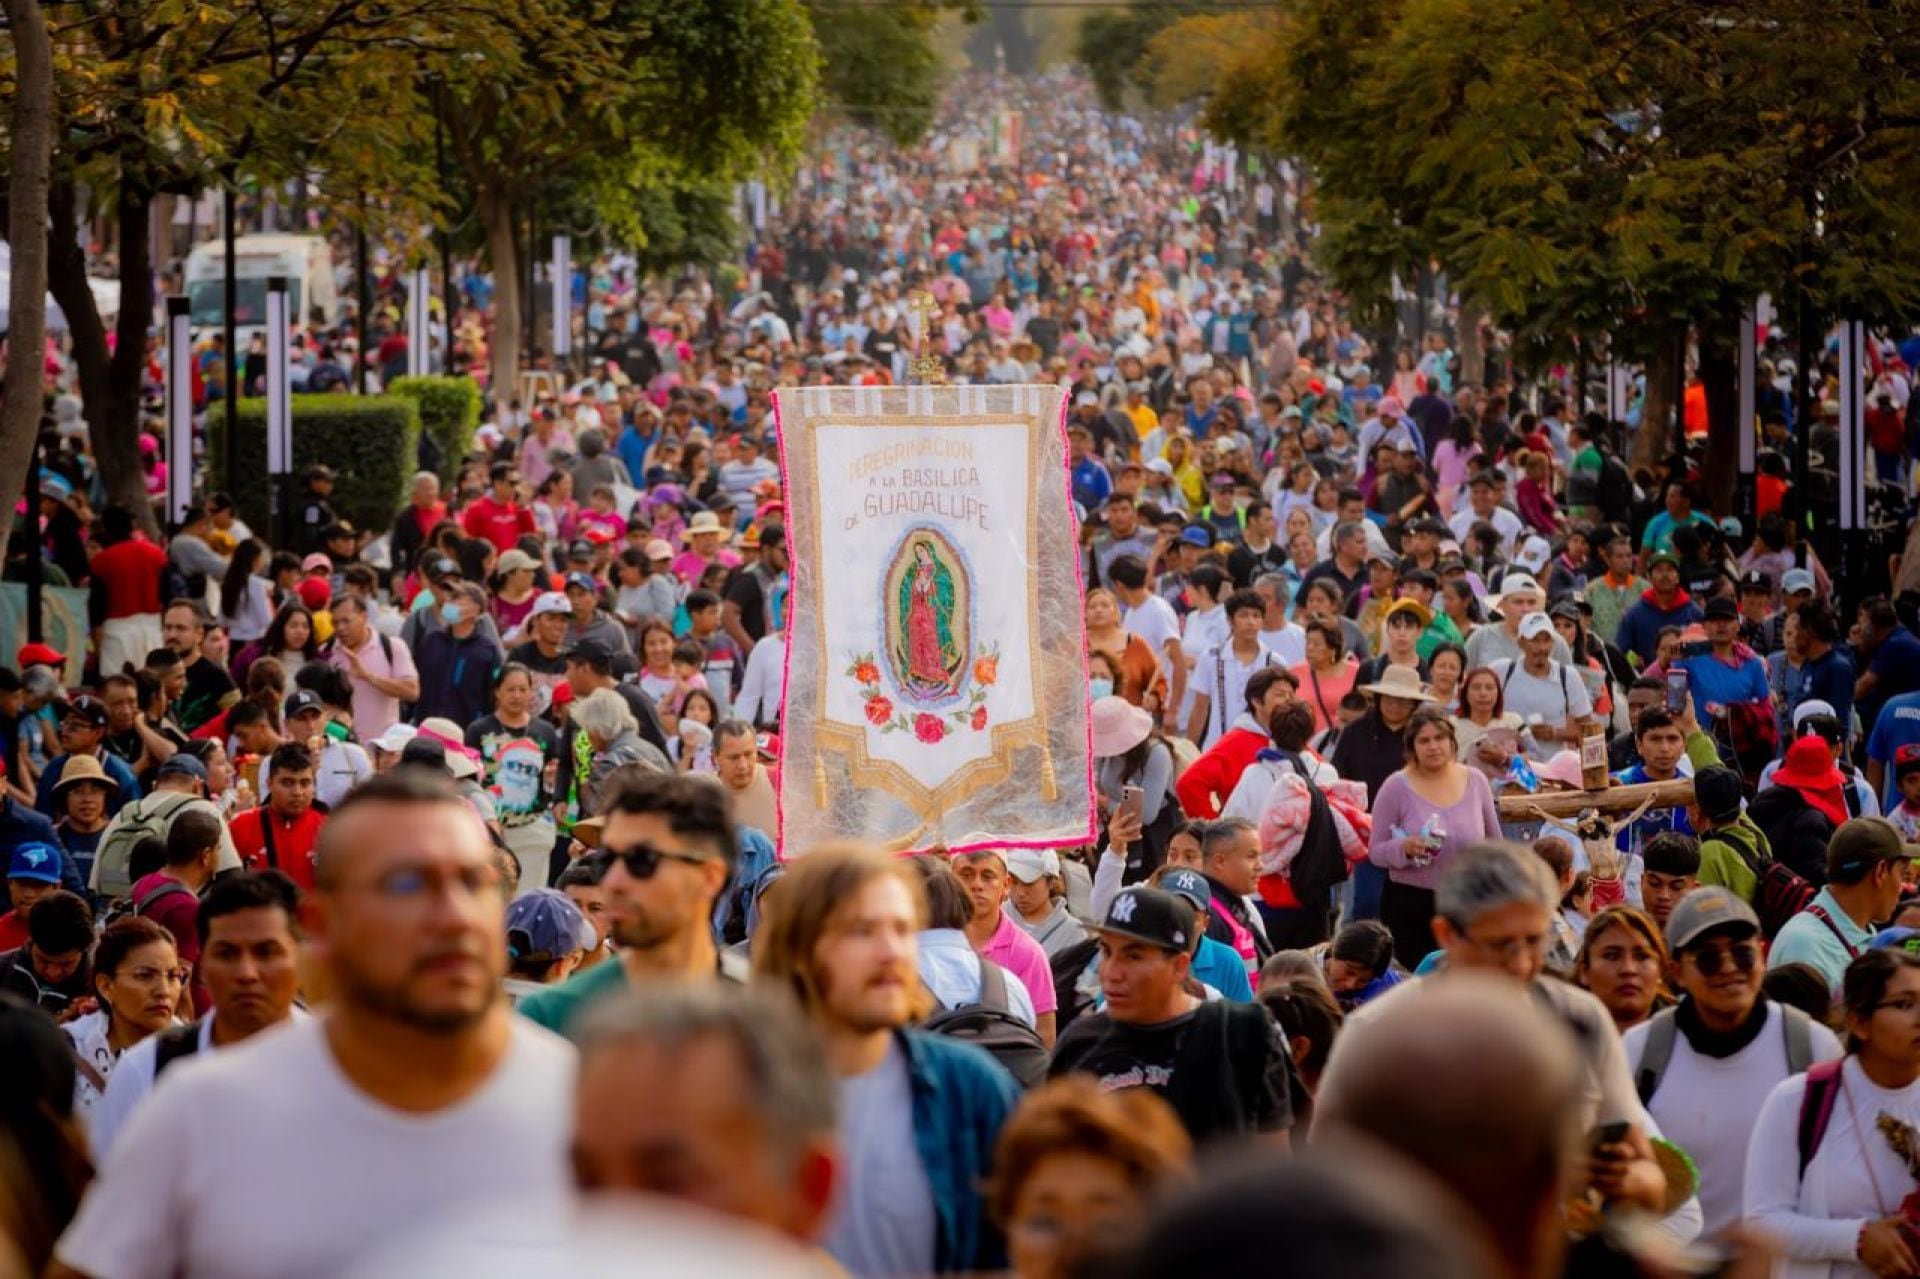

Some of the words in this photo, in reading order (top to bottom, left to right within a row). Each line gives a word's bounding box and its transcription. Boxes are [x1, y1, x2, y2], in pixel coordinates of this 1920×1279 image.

[882, 476, 896, 488] LA
[902, 466, 981, 488] BASILICA
[864, 490, 990, 531] GUADALUPE
